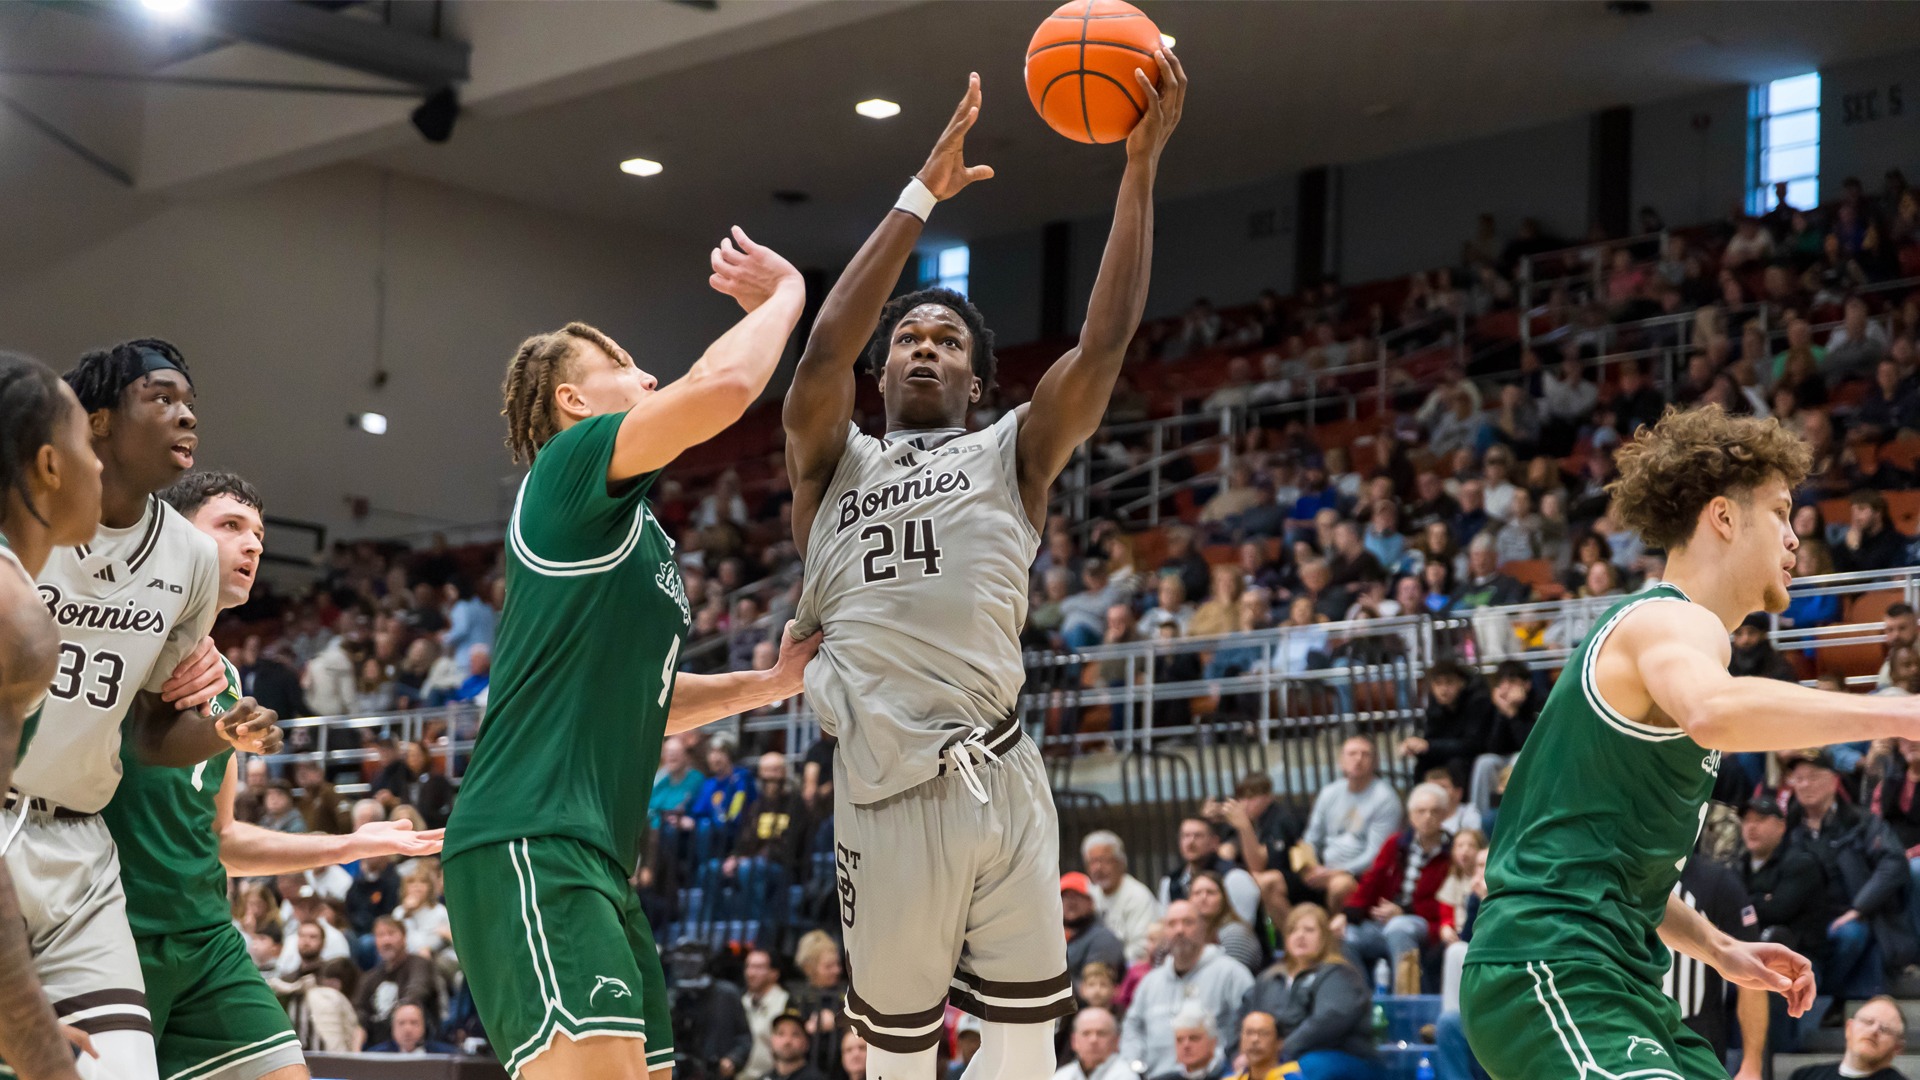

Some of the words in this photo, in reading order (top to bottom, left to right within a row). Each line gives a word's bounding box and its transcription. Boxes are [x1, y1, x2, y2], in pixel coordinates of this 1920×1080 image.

[835, 469, 972, 537] Bonnies
[859, 517, 943, 584] 24
[49, 640, 126, 710] 33
[658, 633, 681, 708] 4
